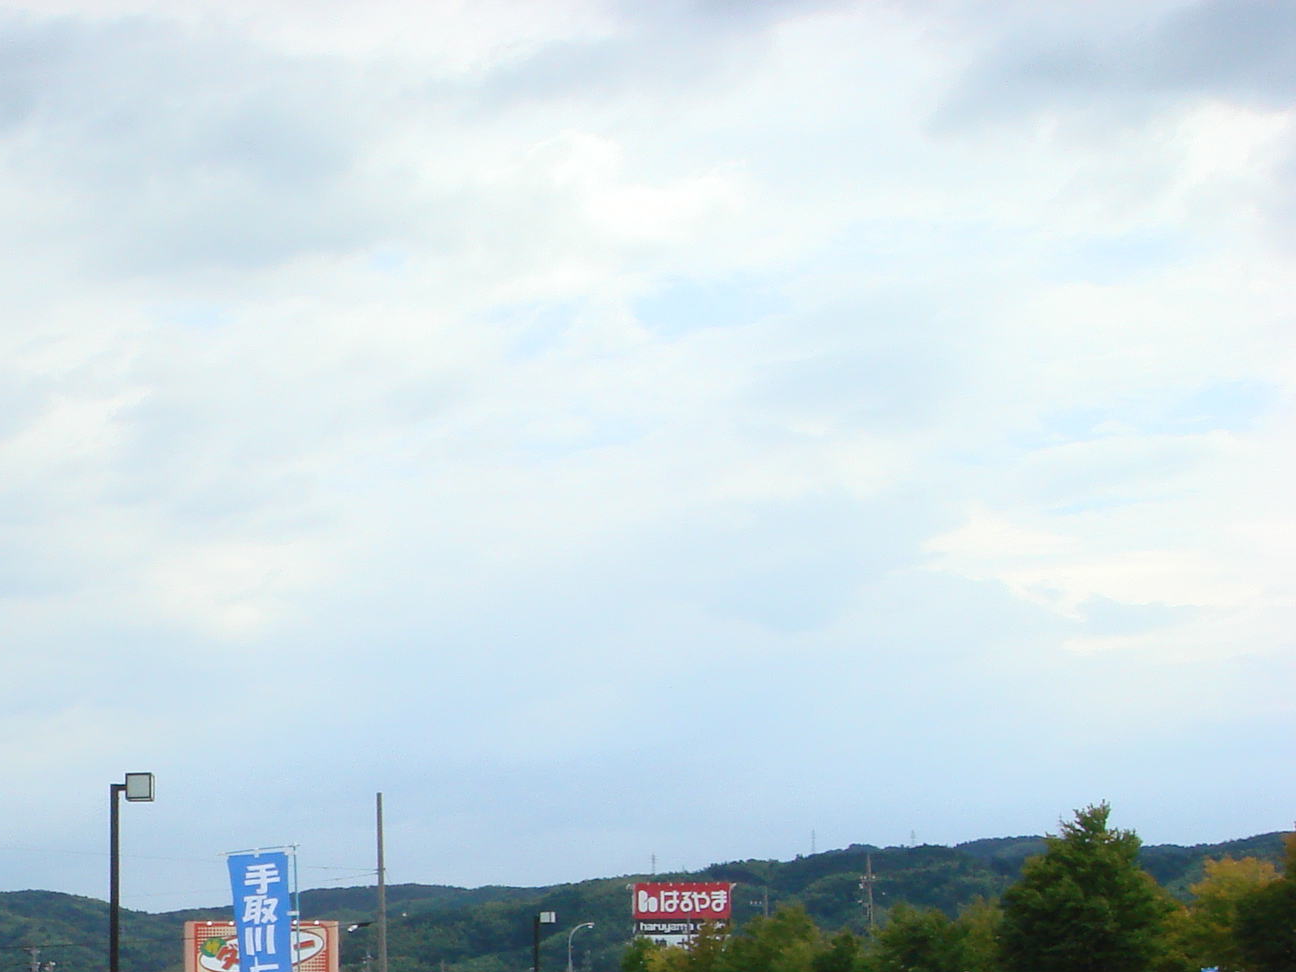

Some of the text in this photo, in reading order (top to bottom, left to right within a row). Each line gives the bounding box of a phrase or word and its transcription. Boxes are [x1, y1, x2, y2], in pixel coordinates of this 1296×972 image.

[660, 890, 727, 912] はるやま
[640, 922, 694, 933] haruyama
